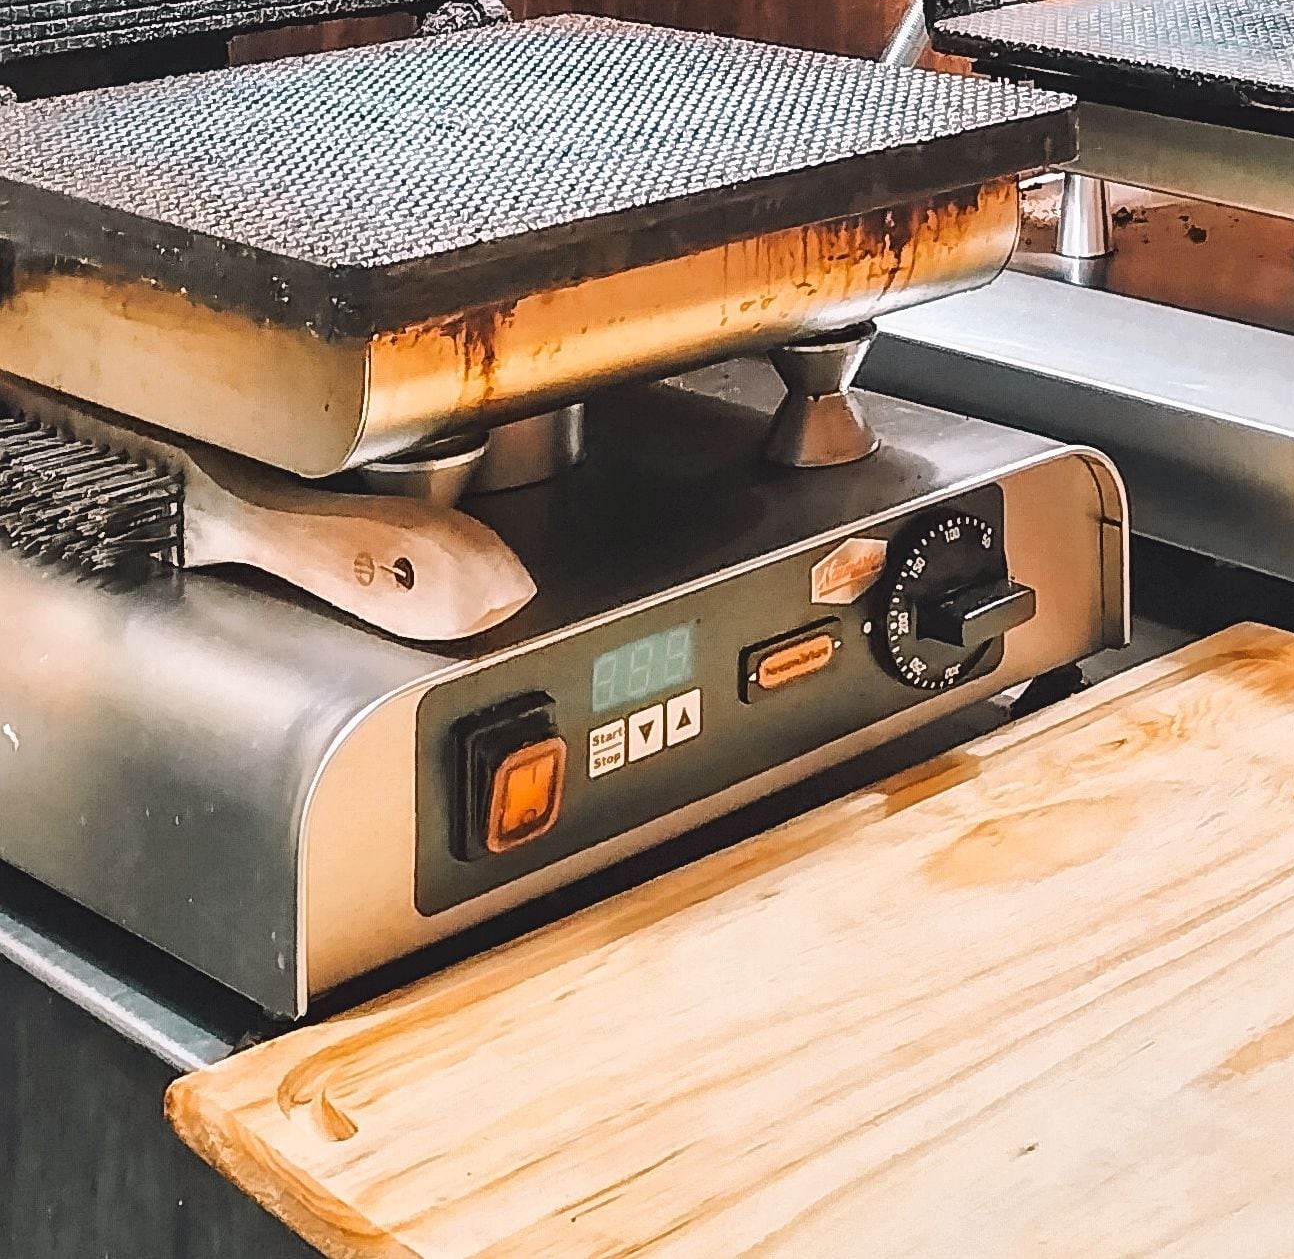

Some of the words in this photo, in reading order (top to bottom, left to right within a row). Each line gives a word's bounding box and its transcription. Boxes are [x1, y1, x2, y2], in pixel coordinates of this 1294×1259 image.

[944, 526, 961, 543] 100
[909, 556, 926, 579] 150
[897, 611, 909, 635] 200
[592, 726, 623, 747] Start
[593, 751, 621, 770] Stop
